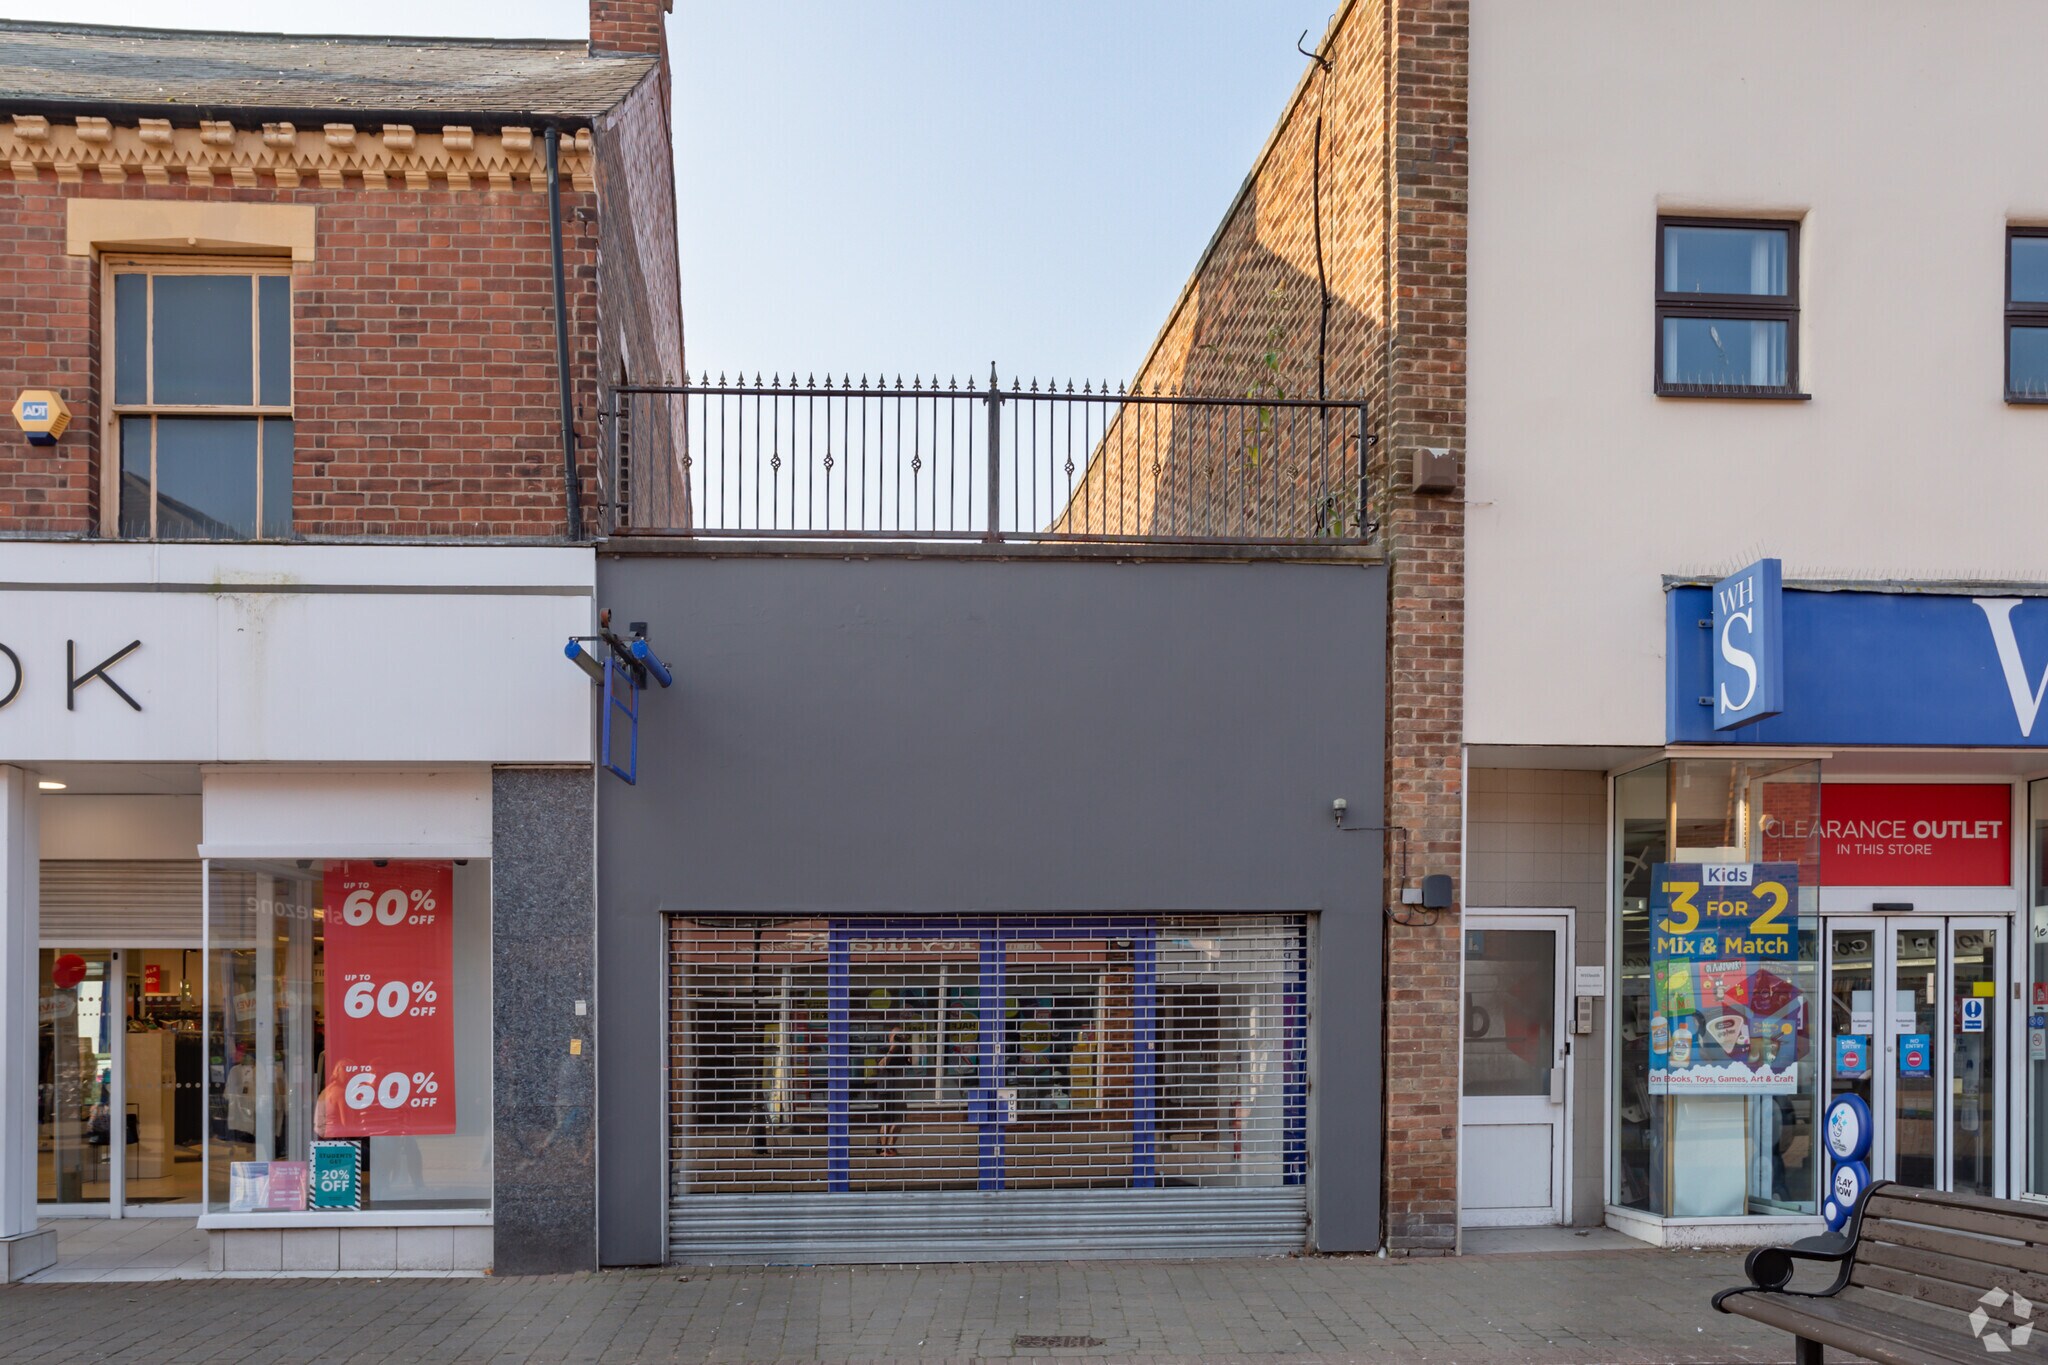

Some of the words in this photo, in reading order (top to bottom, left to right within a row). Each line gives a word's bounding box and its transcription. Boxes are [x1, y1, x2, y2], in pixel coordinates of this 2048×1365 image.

[23, 405, 48, 416] ADT
[1719, 575, 1754, 616] WH
[1720, 607, 1757, 715] S
[1765, 820, 1906, 839] CLEARANCE
[1912, 820, 2003, 839] OUTLET
[1836, 844, 1850, 855] IN
[1854, 844, 1884, 855] THIS
[1888, 844, 1932, 855] STORE
[1708, 867, 1748, 882] Kids
[342, 889, 436, 926] 60%
[1658, 881, 1700, 935] 3
[1706, 901, 1748, 916] FOR
[1750, 881, 1789, 935] 2
[408, 915, 435, 925] OFF
[1657, 937, 1695, 954] Mix
[1702, 937, 1717, 954] &
[1725, 936, 1789, 954] Match
[343, 980, 437, 1018] 60%
[410, 1007, 437, 1017] OFF
[345, 1065, 358, 1073] UP
[1650, 1075, 1662, 1083] On
[1663, 1075, 1693, 1084] Books,
[1695, 1075, 1716, 1084] Toys,
[1718, 1075, 1748, 1084] Games,
[1751, 1075, 1765, 1083] Art
[1766, 1075, 1772, 1083] &
[1773, 1075, 1794, 1083] Craft
[344, 1071, 439, 1110] 60%
[410, 1098, 438, 1107] OFF
[321, 1169, 350, 1180] 20%
[321, 1180, 350, 1192] OFF
[1837, 1175, 1853, 1188] PLAY
[1836, 1185, 1852, 1198] NOW
